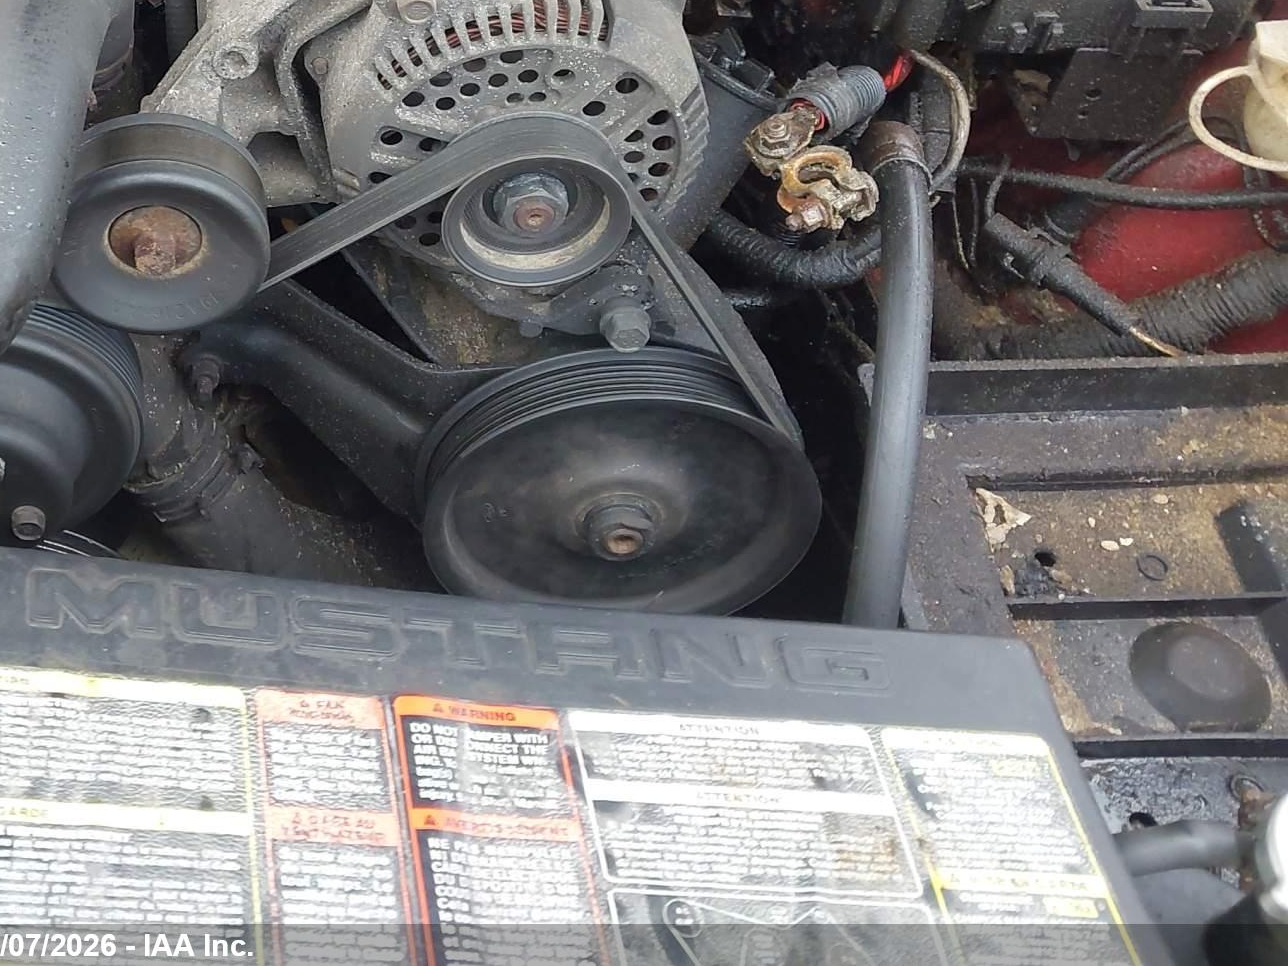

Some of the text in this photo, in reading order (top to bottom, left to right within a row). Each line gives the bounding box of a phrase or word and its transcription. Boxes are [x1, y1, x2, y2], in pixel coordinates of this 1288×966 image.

[25, 567, 895, 697] MUSTANG
[447, 705, 517, 722] WARNING
[409, 722, 431, 733] DO
[432, 724, 458, 736] NOT
[513, 734, 550, 744] WITH
[411, 734, 433, 744] OR
